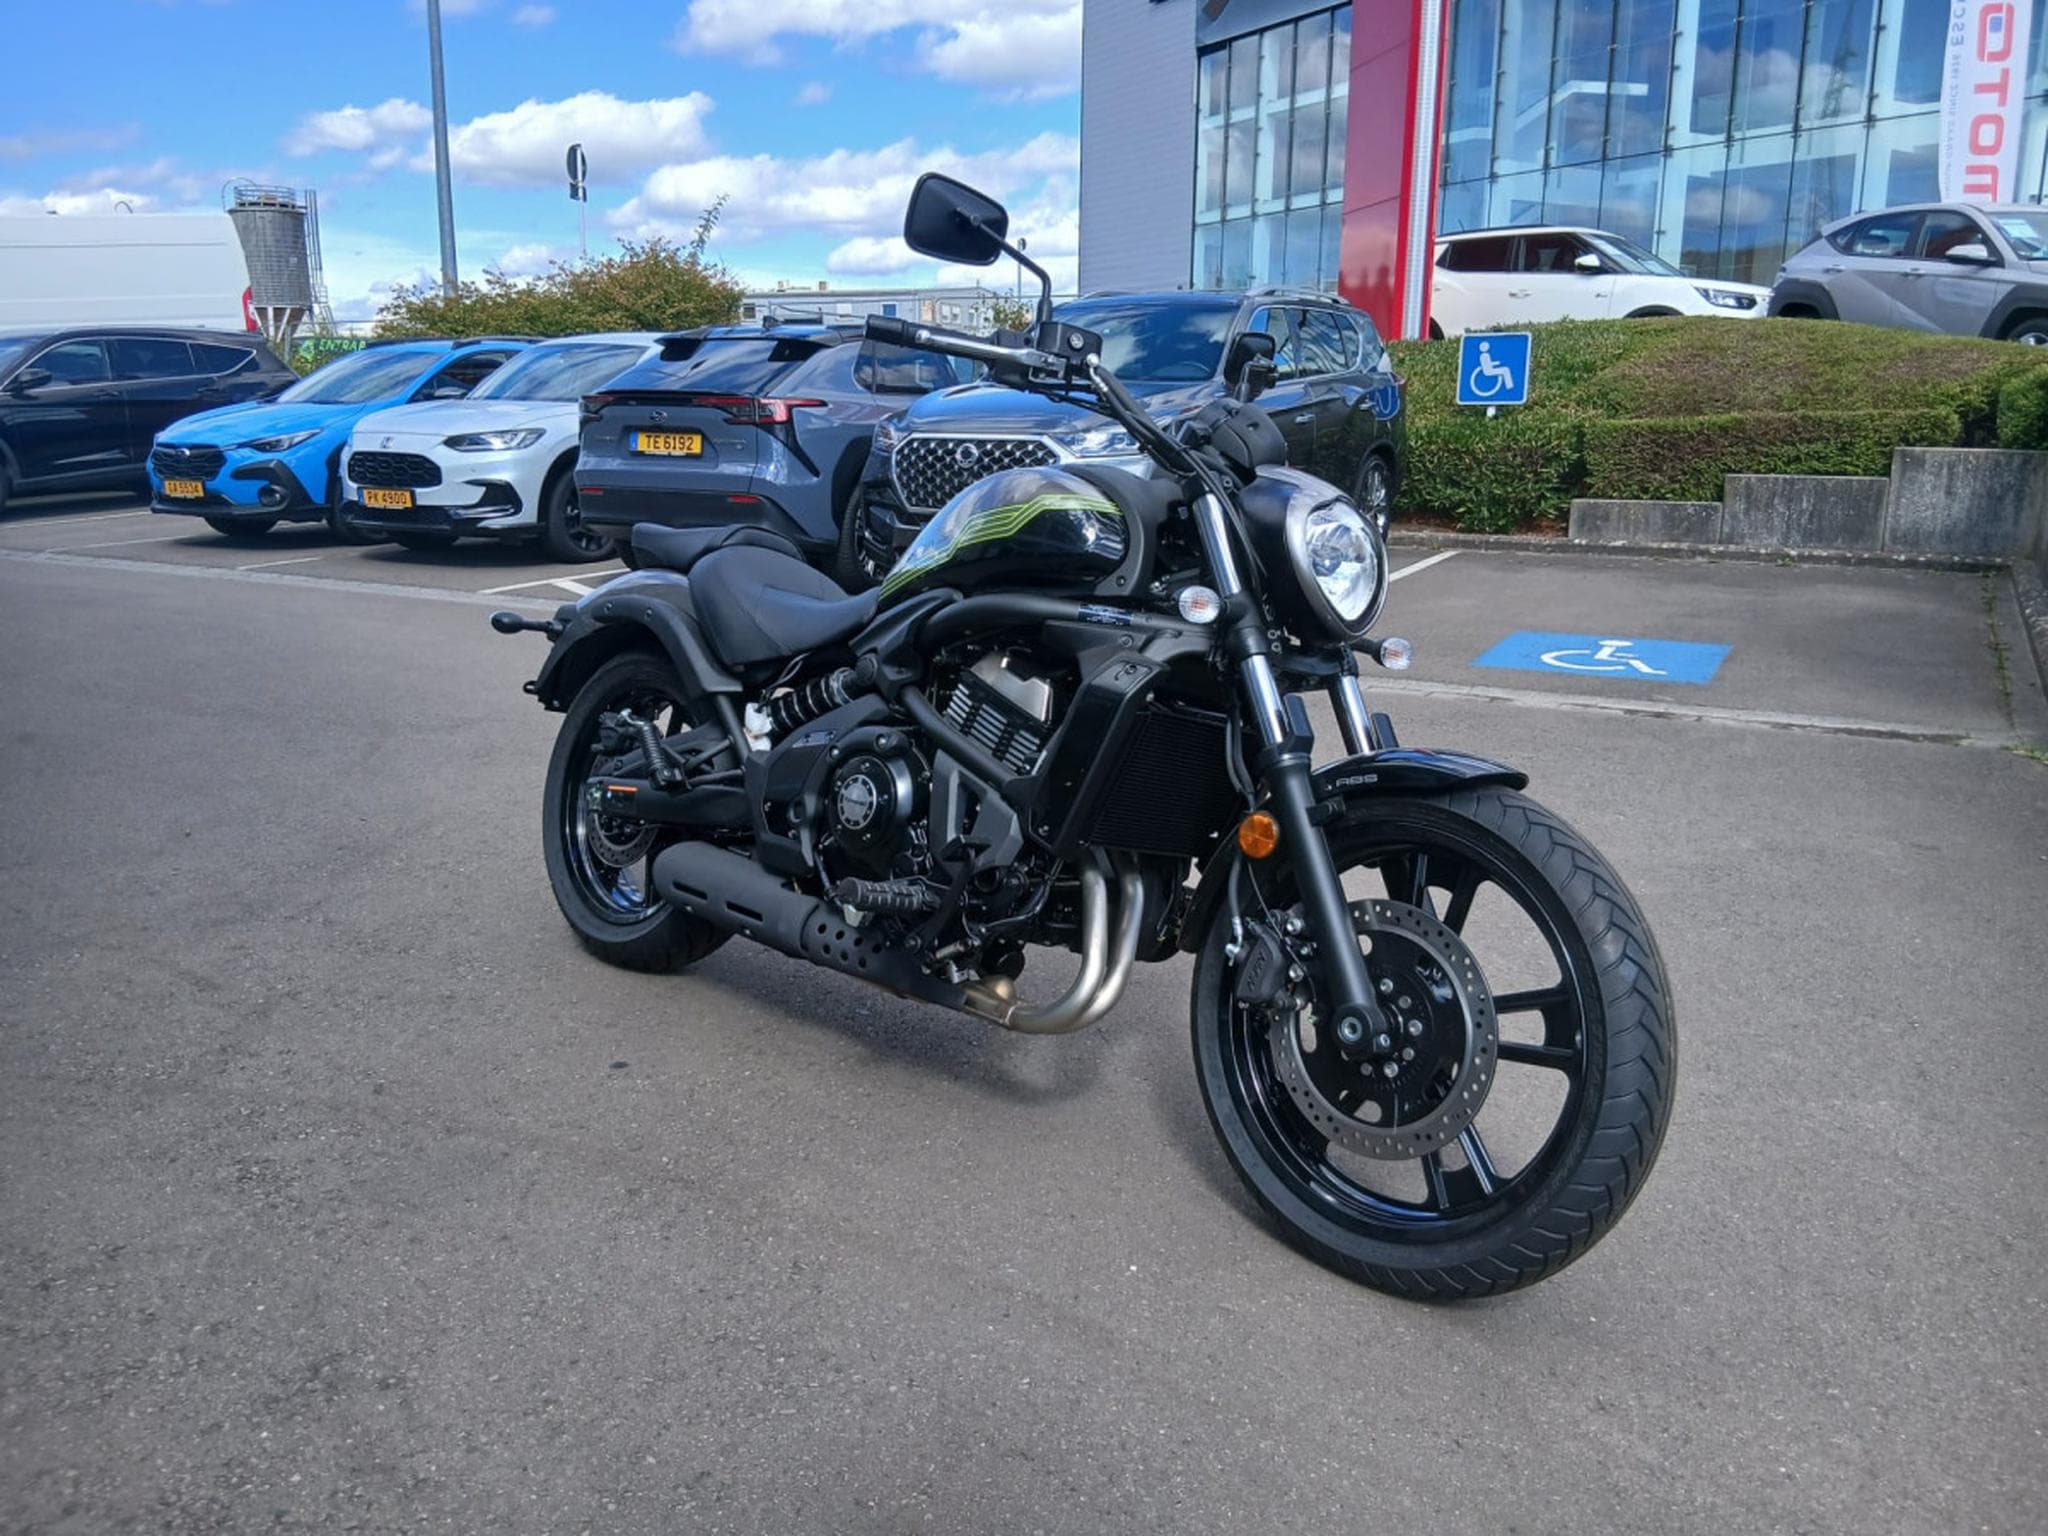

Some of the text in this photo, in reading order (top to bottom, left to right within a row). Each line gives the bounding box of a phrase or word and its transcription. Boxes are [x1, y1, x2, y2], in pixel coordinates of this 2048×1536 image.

[645, 434, 661, 449] TE
[663, 435, 695, 451] 6192
[1336, 774, 1378, 787] ABS
